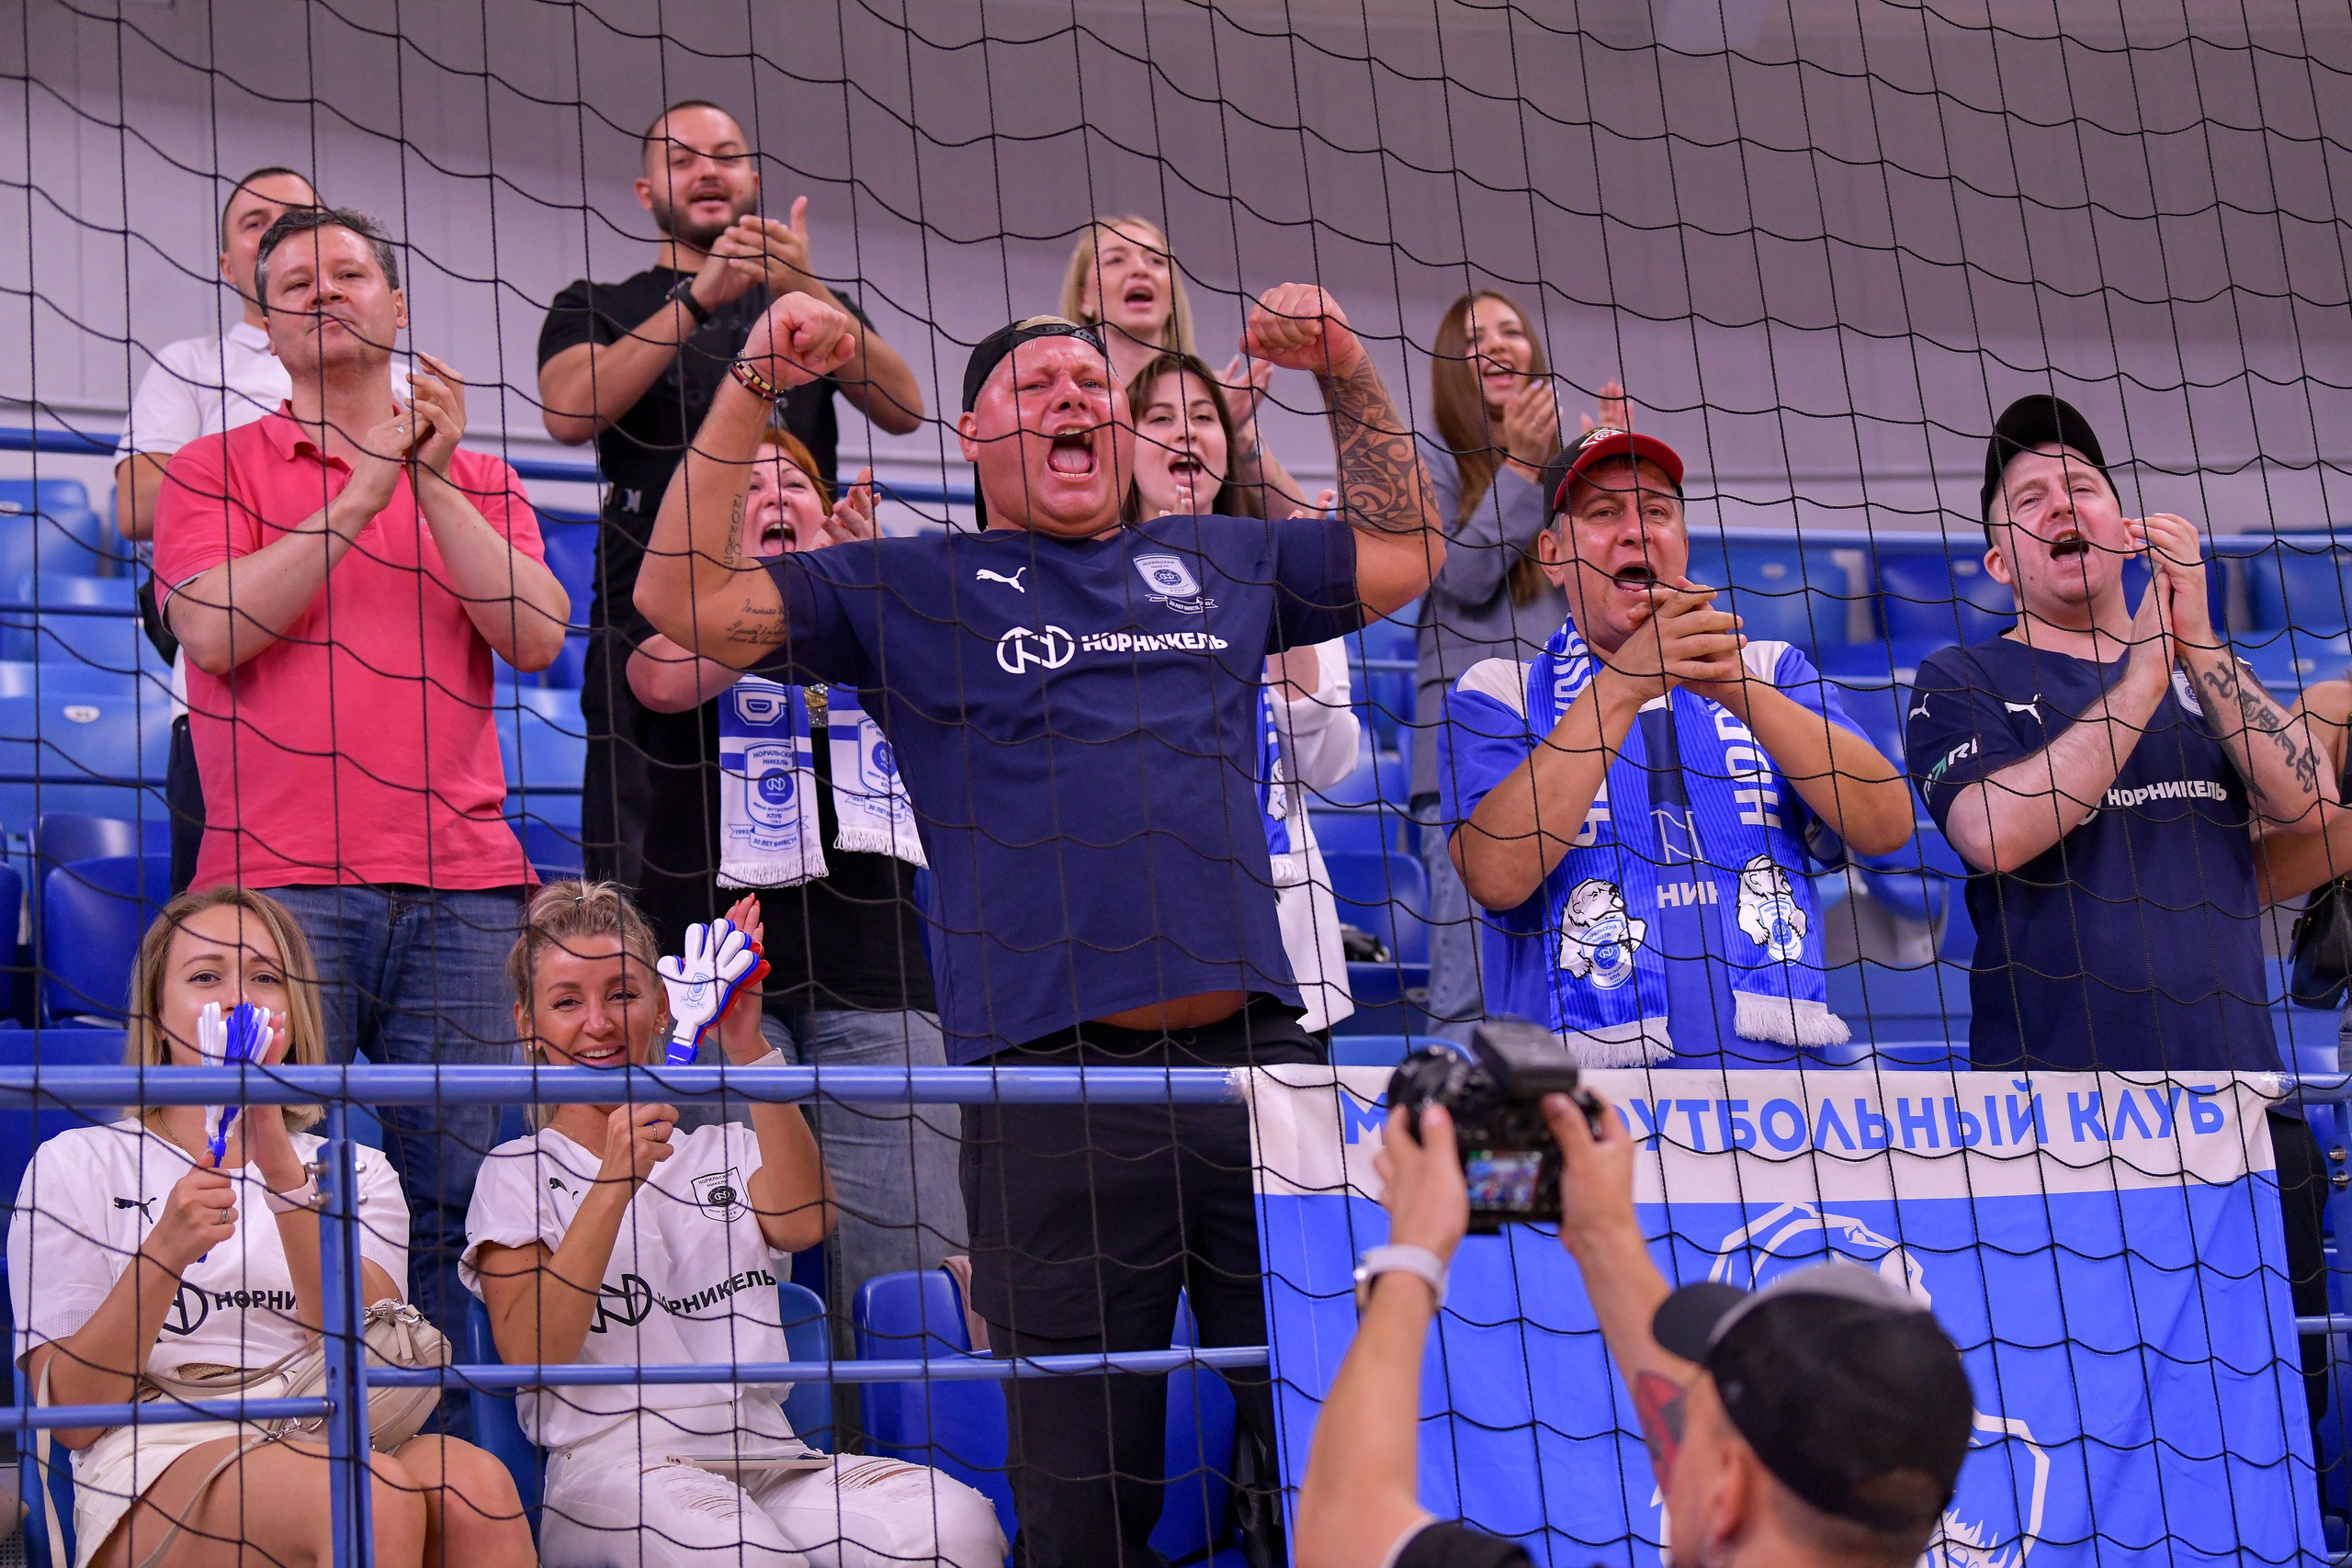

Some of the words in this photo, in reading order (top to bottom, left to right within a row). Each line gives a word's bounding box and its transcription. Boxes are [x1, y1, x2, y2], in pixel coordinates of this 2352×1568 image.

[1080, 632, 1228, 652] НОРНИКЕЛЬ
[2107, 780, 2227, 807] НОРНИКЕЛЬ
[2067, 1084, 2225, 1143] КЛУБ
[214, 1290, 299, 1311] НОРНИ
[658, 1269, 776, 1315] РНИКЕЛЬ
